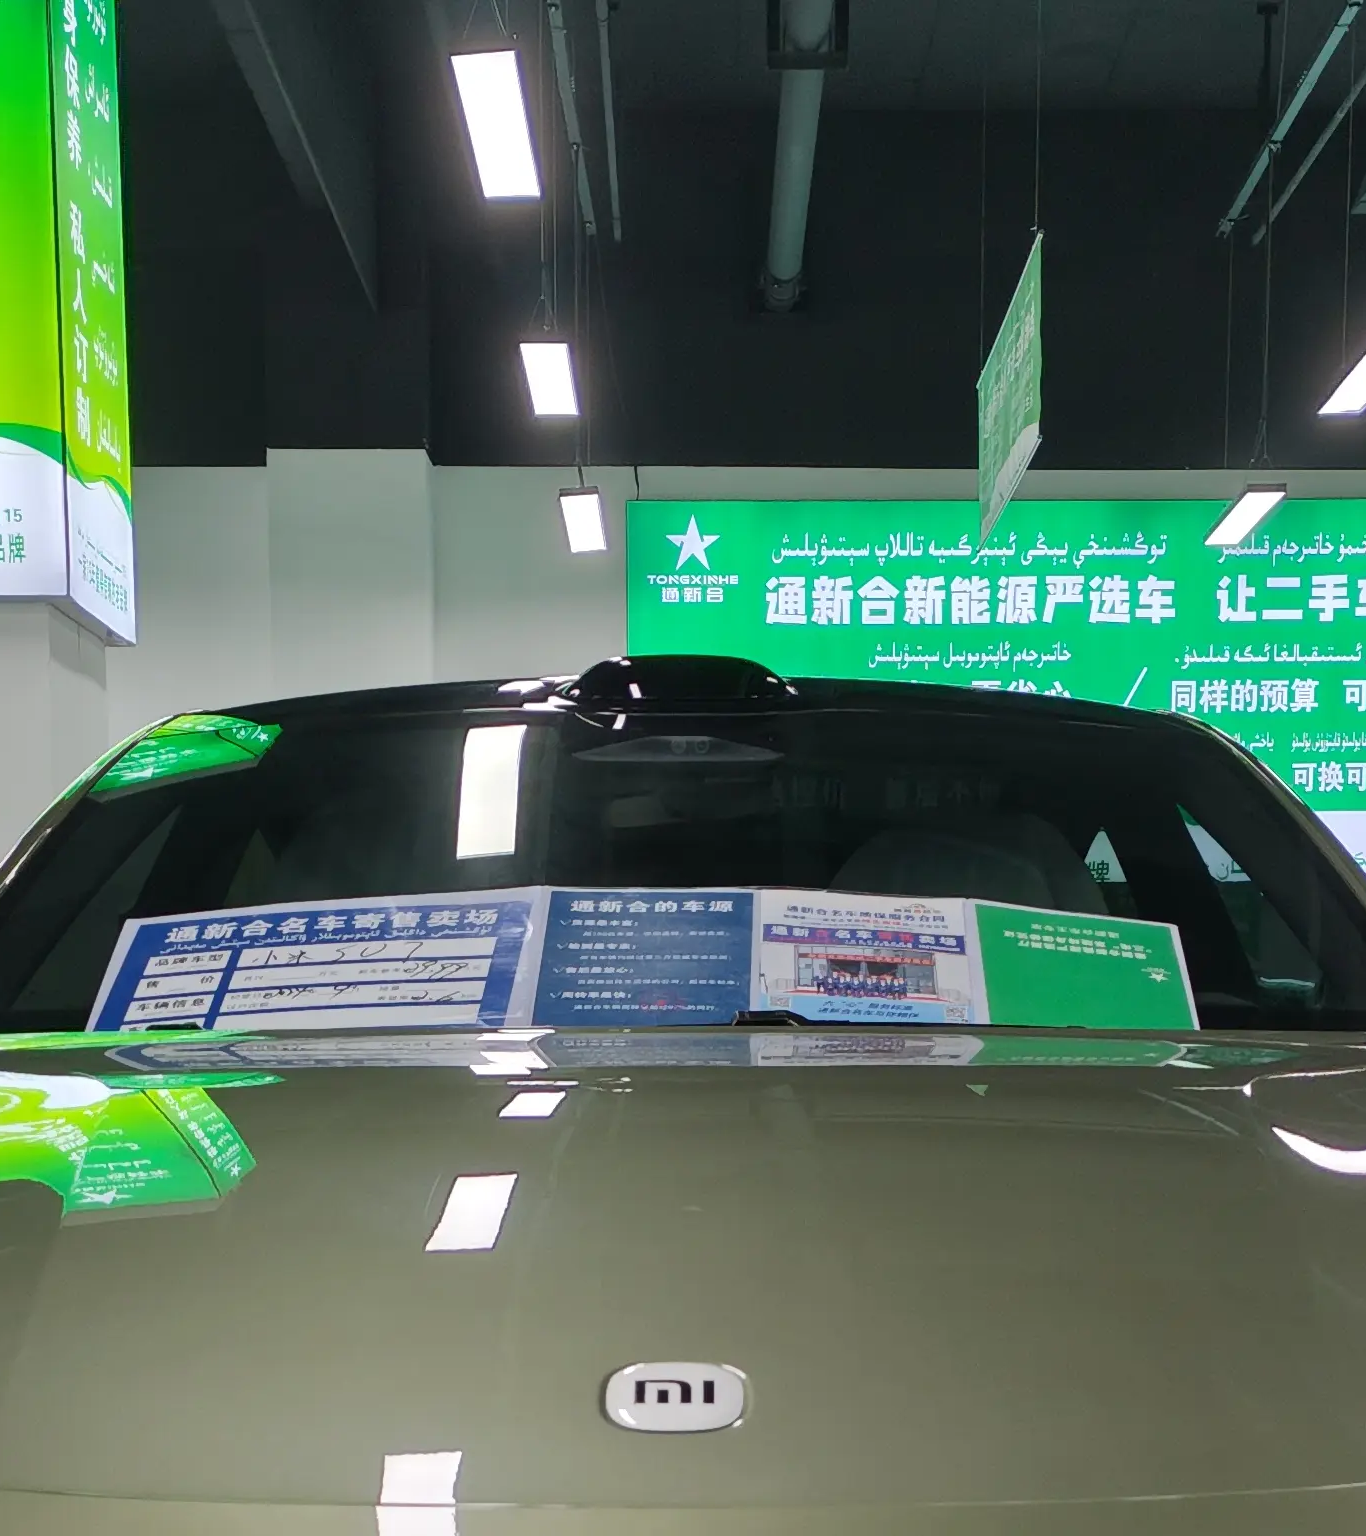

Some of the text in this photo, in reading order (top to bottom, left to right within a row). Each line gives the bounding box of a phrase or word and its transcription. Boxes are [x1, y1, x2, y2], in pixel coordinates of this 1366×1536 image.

[5, 508, 23, 523] 15
[647, 574, 739, 585] TONGXINHE
[661, 586, 724, 603] 通新合
[764, 574, 1176, 625] 通新合新能源严选车
[1170, 679, 1319, 713] 同样的预算
[570, 899, 734, 913] 通新合的车源
[164, 908, 499, 944] 通新合名车寄售卖场
